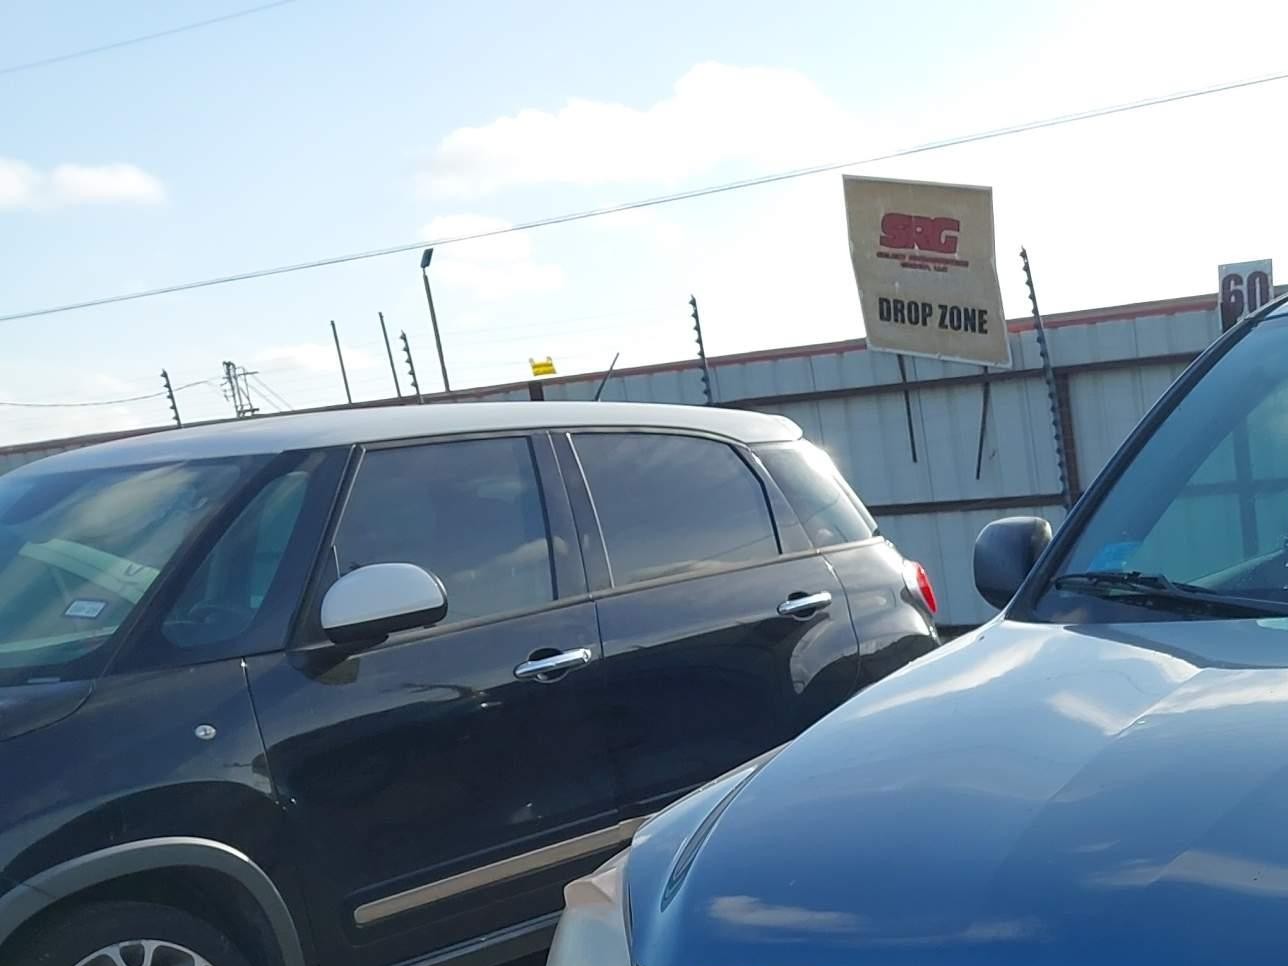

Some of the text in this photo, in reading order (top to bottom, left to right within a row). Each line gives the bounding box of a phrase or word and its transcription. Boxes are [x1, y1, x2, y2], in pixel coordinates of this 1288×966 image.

[880, 212, 961, 254] SRG
[878, 297, 989, 334] DROP ZONE
[1221, 271, 1270, 333] 60
